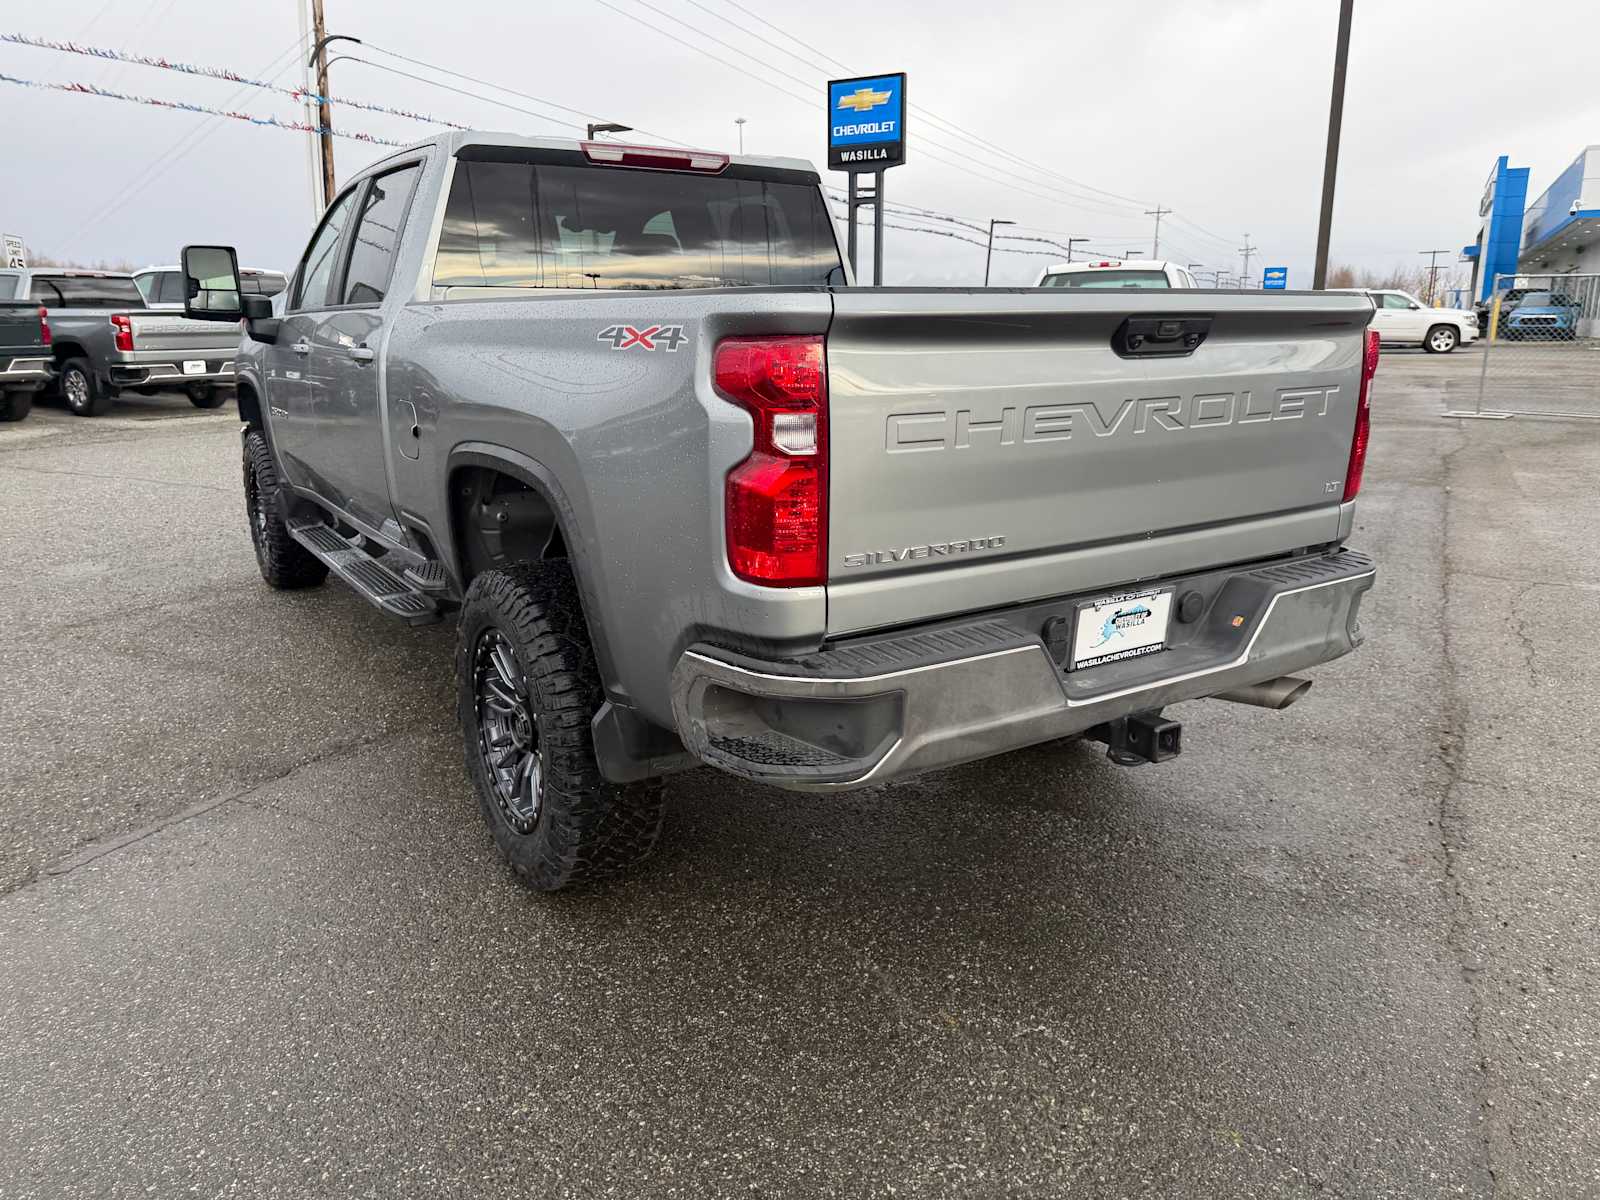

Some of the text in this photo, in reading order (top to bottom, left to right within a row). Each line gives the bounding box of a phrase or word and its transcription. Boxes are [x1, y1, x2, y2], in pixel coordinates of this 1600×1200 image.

[833, 121, 896, 137] CHEVROLET
[841, 148, 888, 162] WASILLA
[9, 257, 25, 268] 45
[885, 384, 1340, 454] CHEVROLET
[843, 535, 1006, 568] SILVERADO
[1076, 643, 1162, 669] WASILLACHEVROLET.COM
